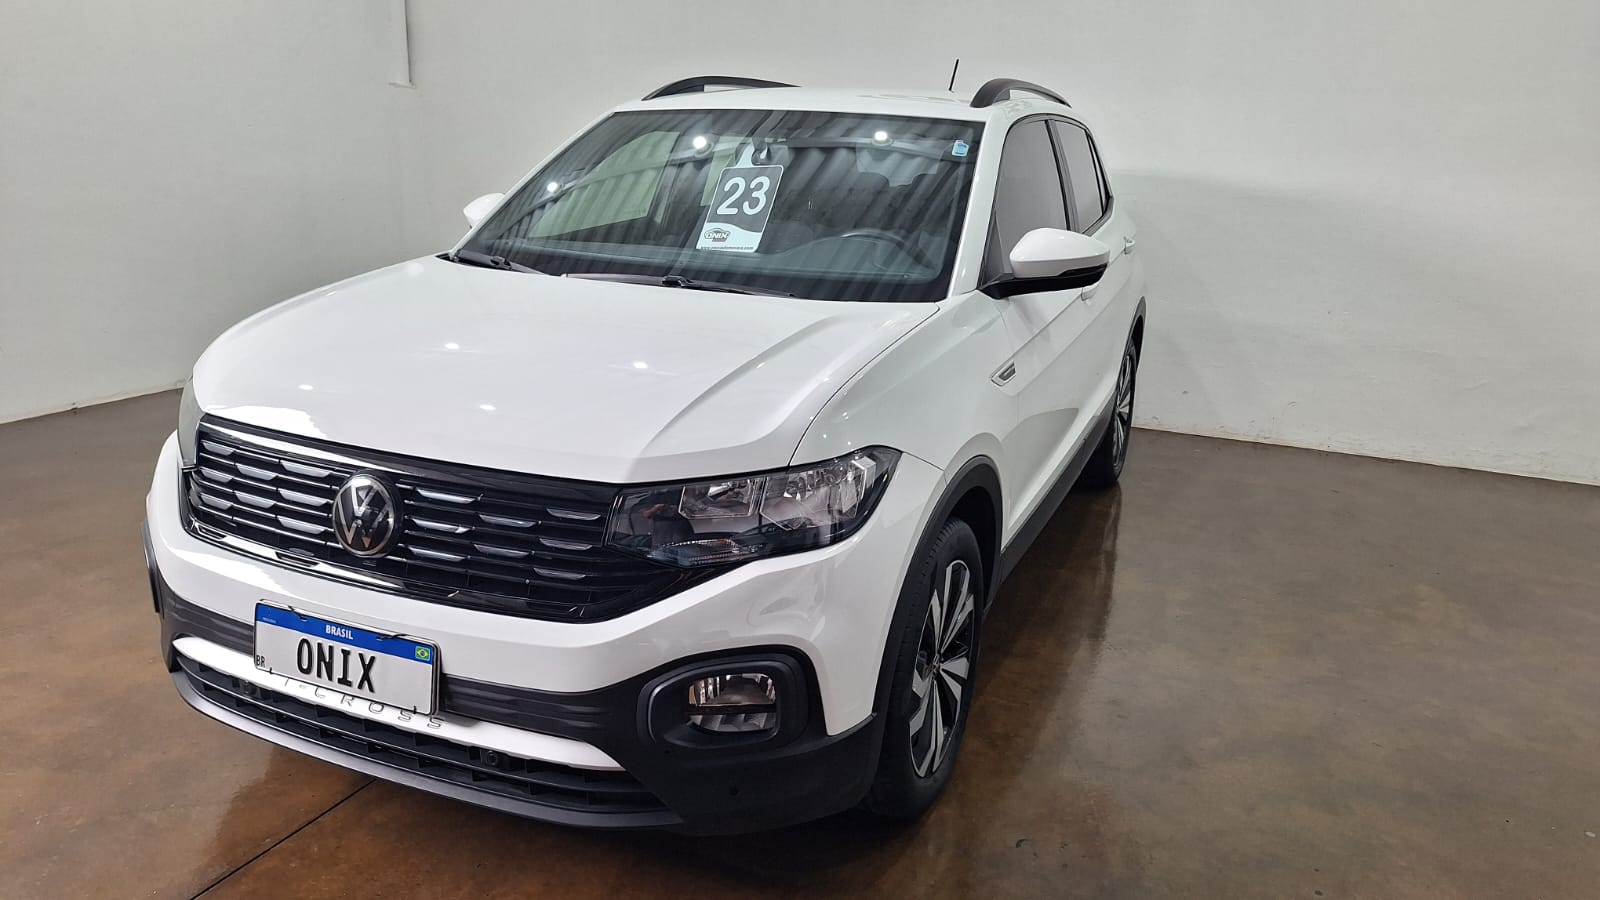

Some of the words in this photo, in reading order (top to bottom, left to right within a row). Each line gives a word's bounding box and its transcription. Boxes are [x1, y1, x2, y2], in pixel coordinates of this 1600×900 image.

[716, 176, 771, 216] 23
[704, 231, 730, 240] ONIX
[325, 624, 354, 640] BRASIL
[255, 654, 266, 668] BR
[296, 637, 377, 694] ONIX
